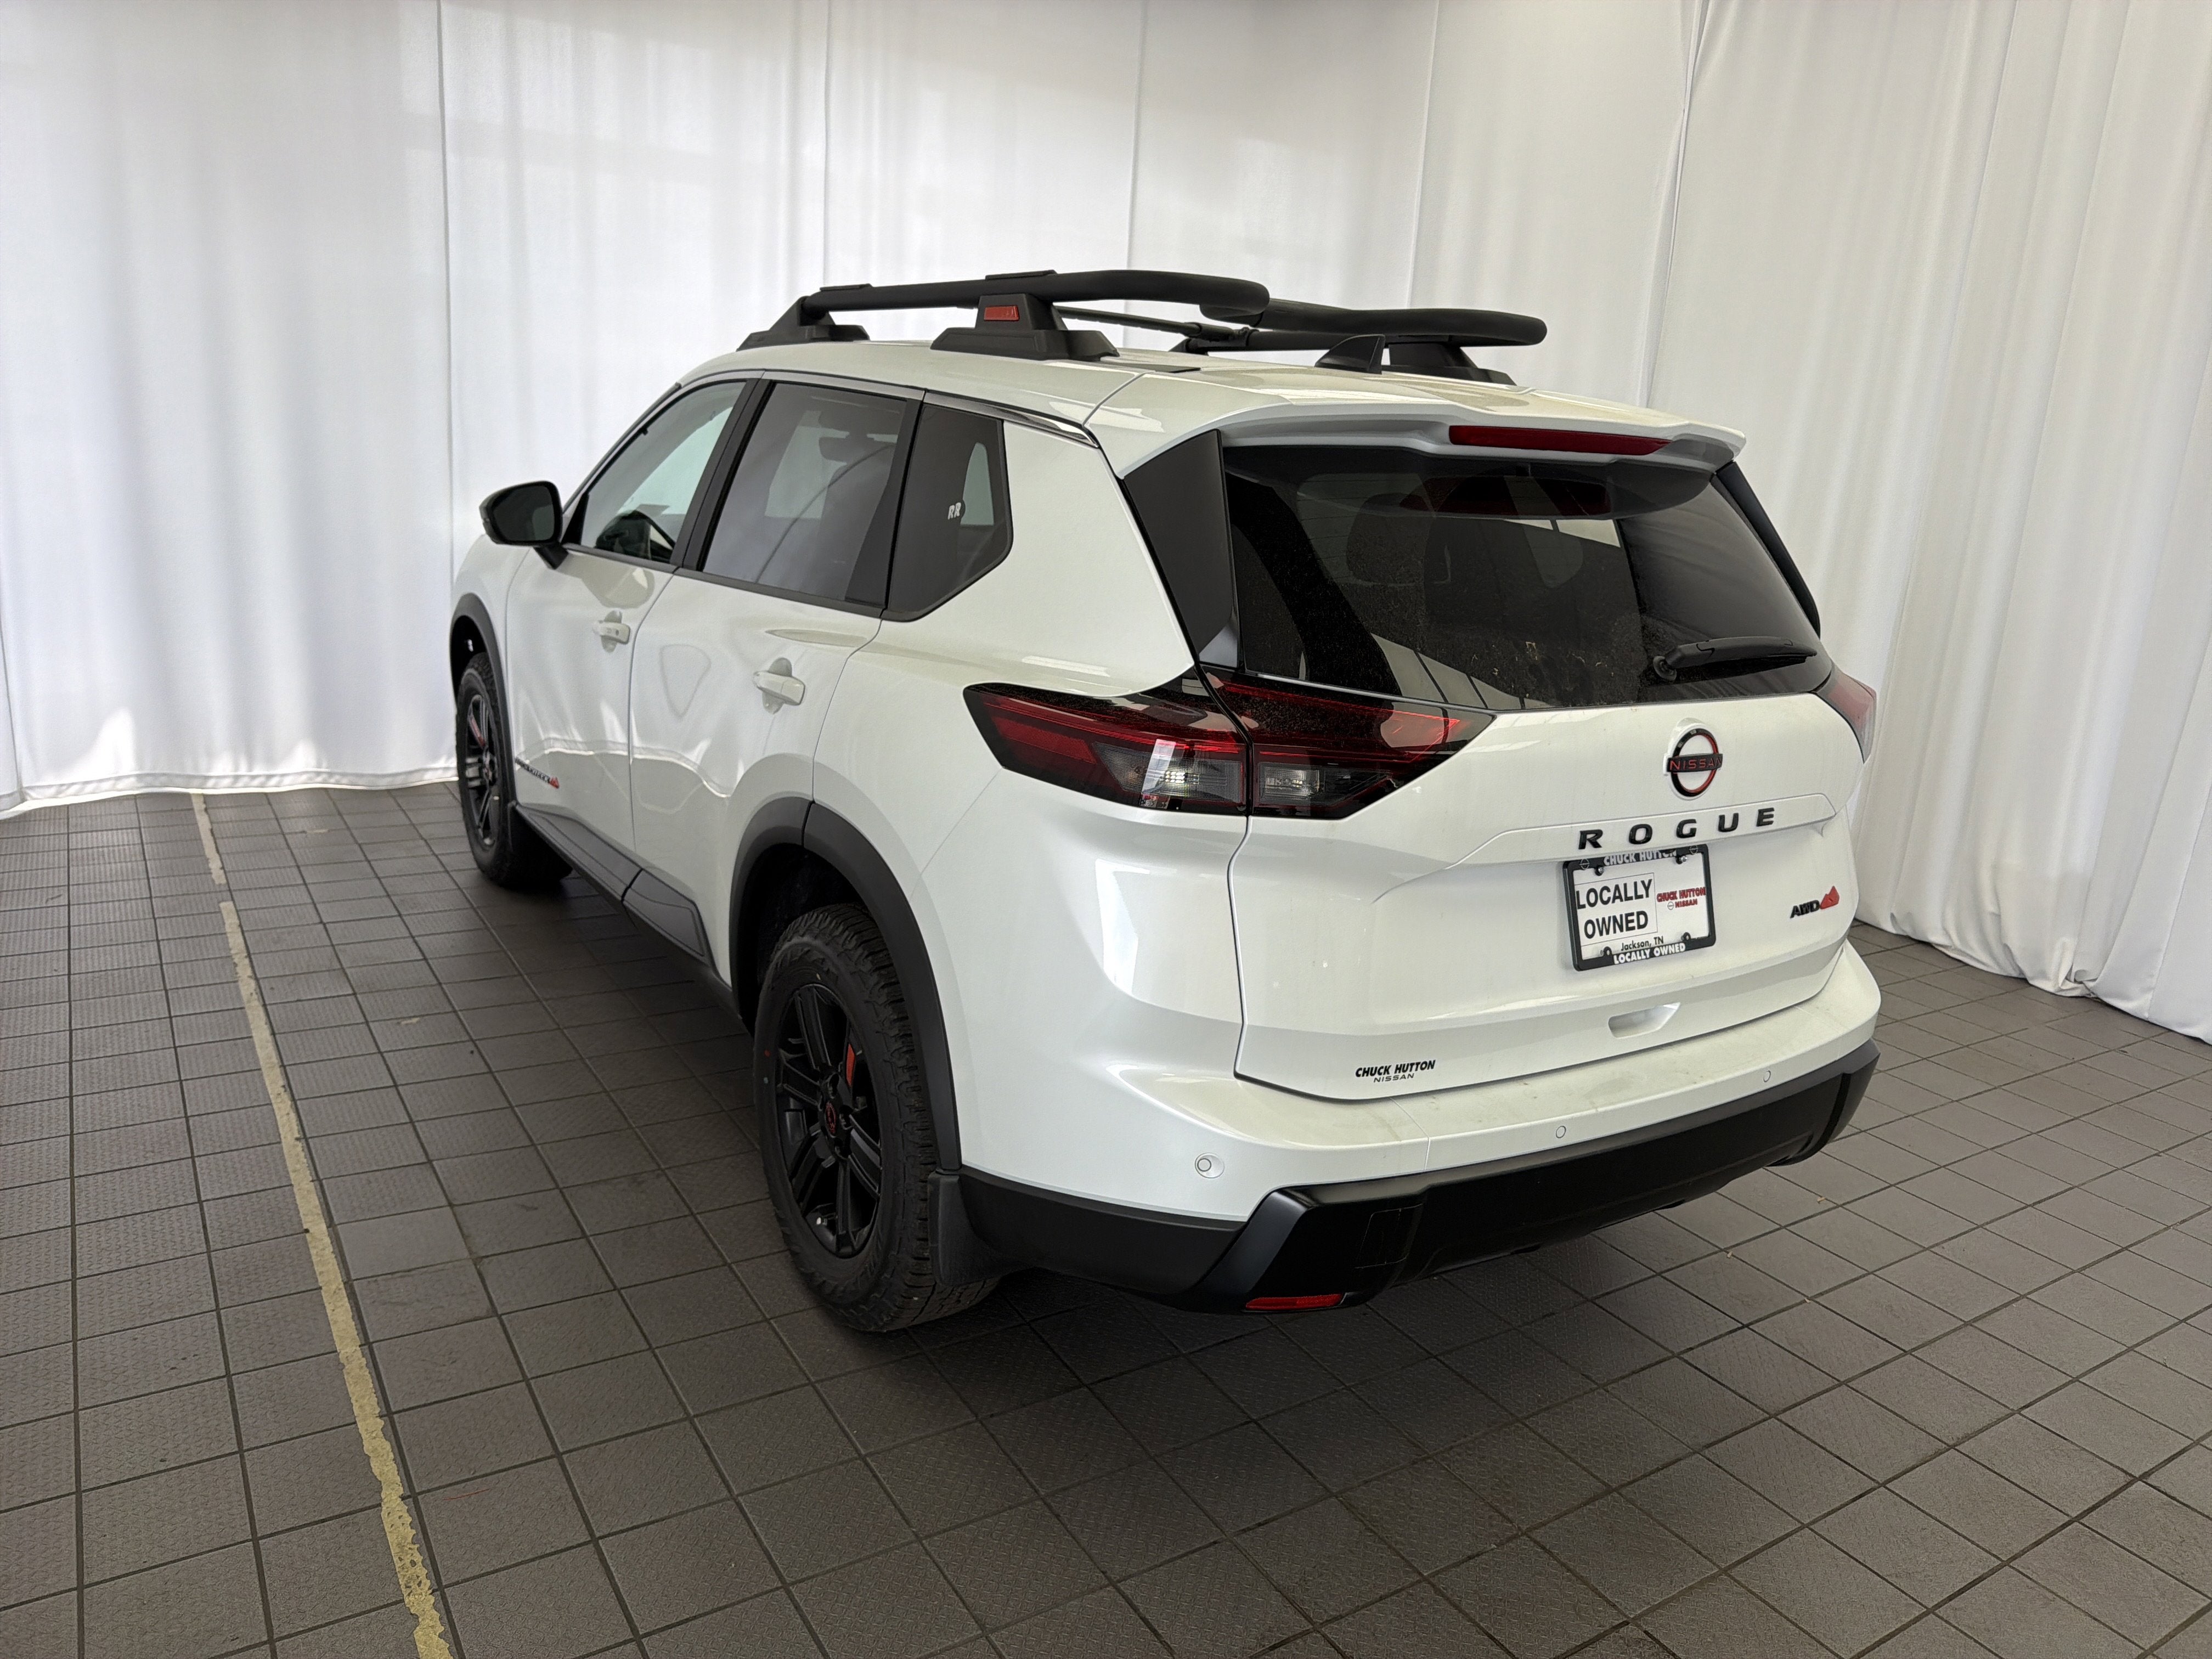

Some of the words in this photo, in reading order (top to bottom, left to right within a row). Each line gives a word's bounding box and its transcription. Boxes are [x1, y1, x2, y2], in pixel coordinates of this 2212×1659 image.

[1669, 758, 1722, 771] NISSAN
[1578, 808, 1775, 850] ROGUE
[1604, 853, 1637, 866] CHUCK
[1576, 879, 1653, 910] LOCALLY
[1656, 891, 1678, 902] CHUCK
[1679, 887, 1707, 899] HUTTON
[1675, 899, 1698, 909] NISSAN
[1790, 899, 1820, 919] AWD
[1584, 910, 1649, 939] OWNED
[1621, 940, 1652, 951] Jackson,
[1654, 936, 1664, 945] TN
[1613, 948, 1651, 965] LOCALLY
[1654, 943, 1686, 957] OWNED
[1355, 1064, 1392, 1077] CHUCK
[1394, 1059, 1436, 1074] HUTTON
[1373, 1073, 1415, 1083] NISSAN
